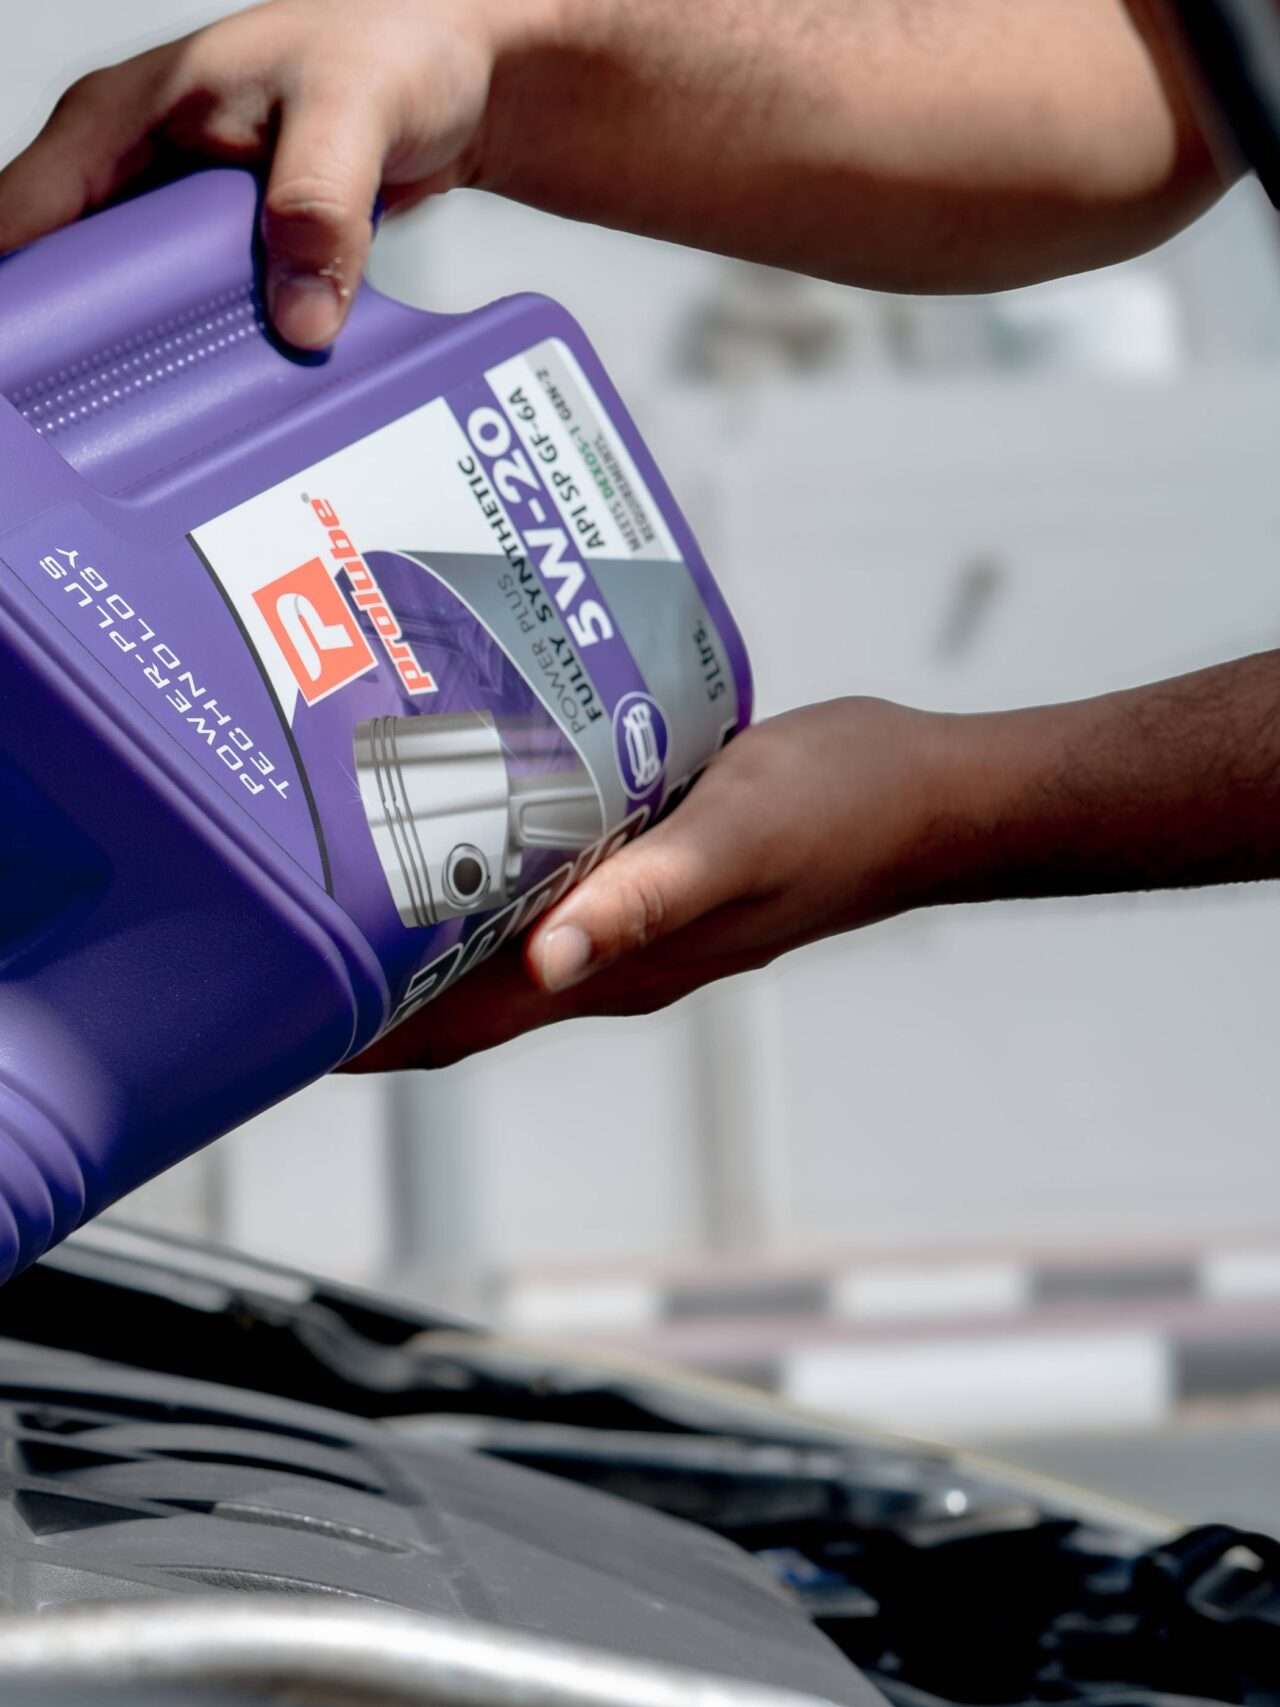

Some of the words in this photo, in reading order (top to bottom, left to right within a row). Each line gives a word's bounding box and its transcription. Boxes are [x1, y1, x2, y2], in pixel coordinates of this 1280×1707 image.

[509, 387, 558, 463] GF-6A
[467, 406, 614, 648] 5W-20
[551, 470, 581, 502] SP
[570, 505, 605, 549] API
[458, 456, 553, 624] SYNTHETIC
[310, 498, 436, 693] prolube
[497, 573, 535, 634] PLUS
[39, 556, 265, 795] POWER-PLUS
[55, 547, 290, 799] TECHNOLOGY
[531, 638, 586, 735] POWER
[549, 637, 603, 722] FULLY
[708, 681, 726, 702] 5
